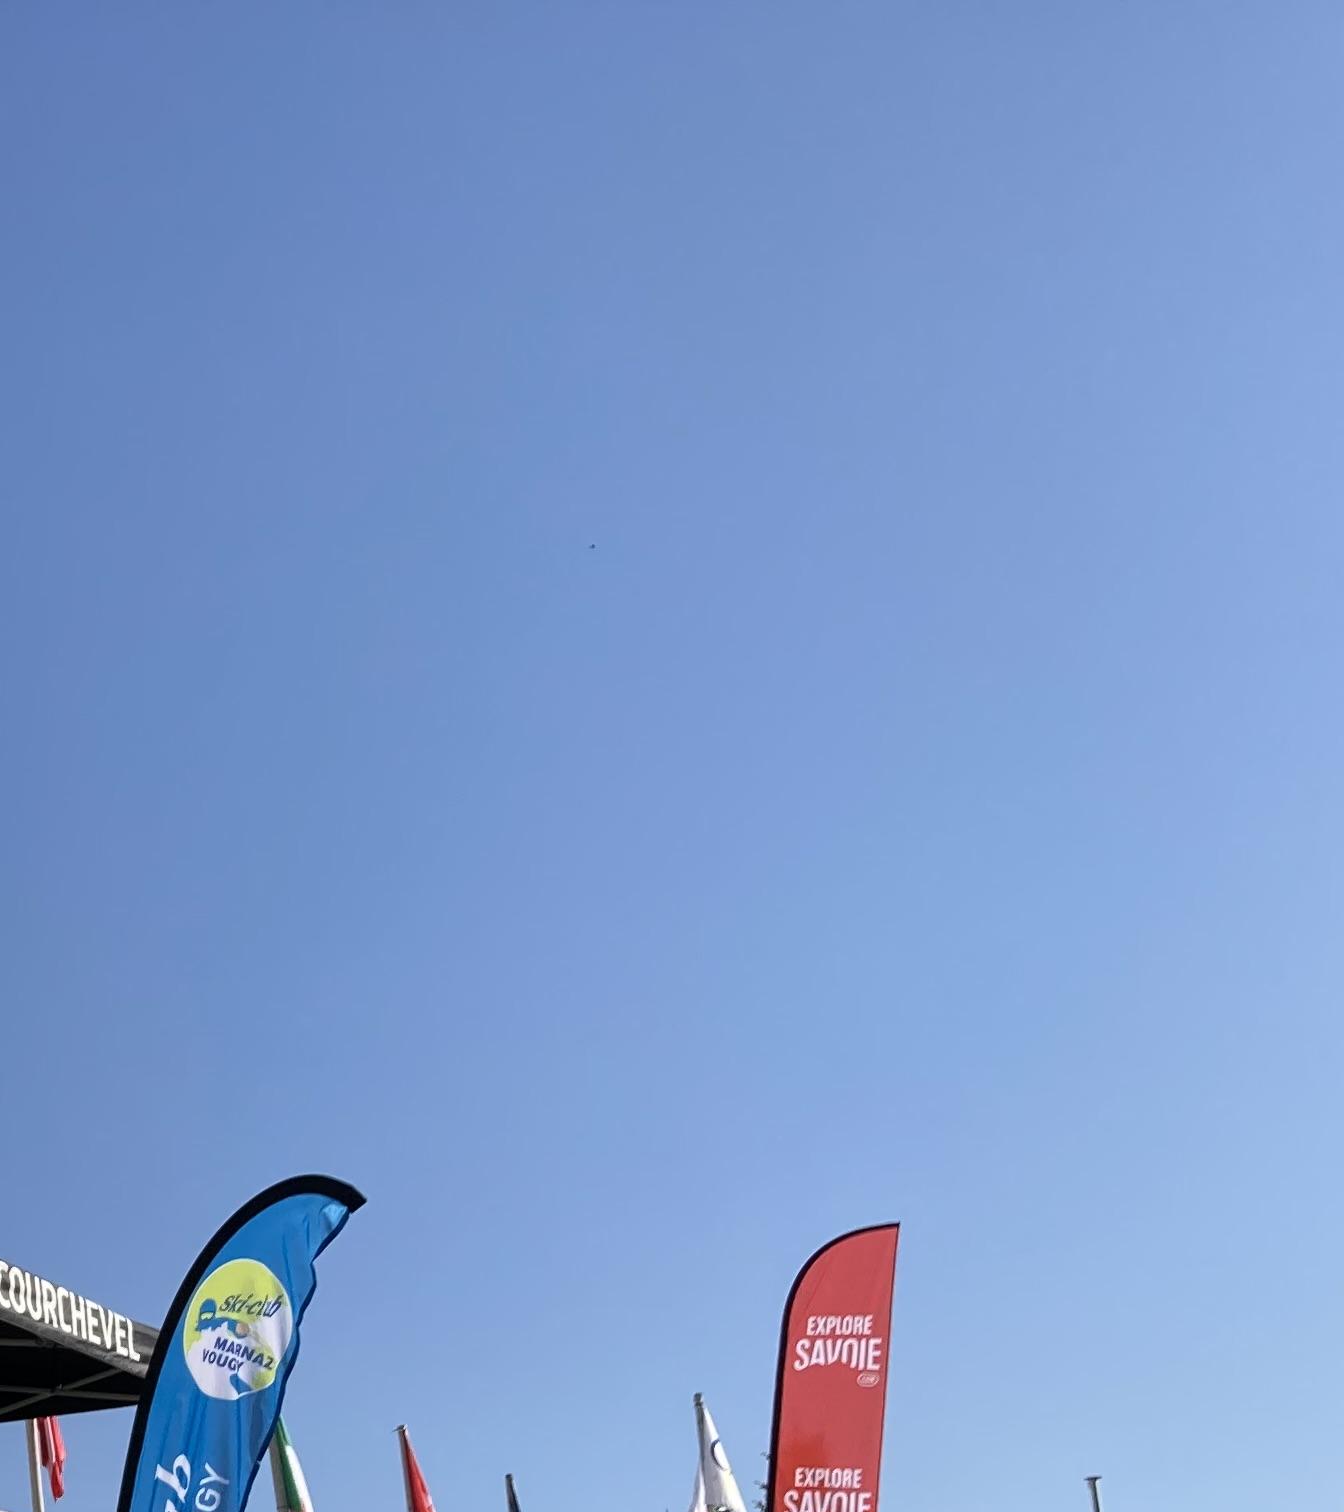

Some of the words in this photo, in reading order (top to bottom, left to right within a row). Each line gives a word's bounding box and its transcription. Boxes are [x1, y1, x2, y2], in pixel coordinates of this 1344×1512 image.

[806, 1314, 874, 1336] EXPLORE
[202, 1348, 244, 1373] VOUGY
[213, 1336, 275, 1370] MARNAZ
[793, 1337, 882, 1371] SAVOIE
[794, 1467, 863, 1489] EXPLORE
